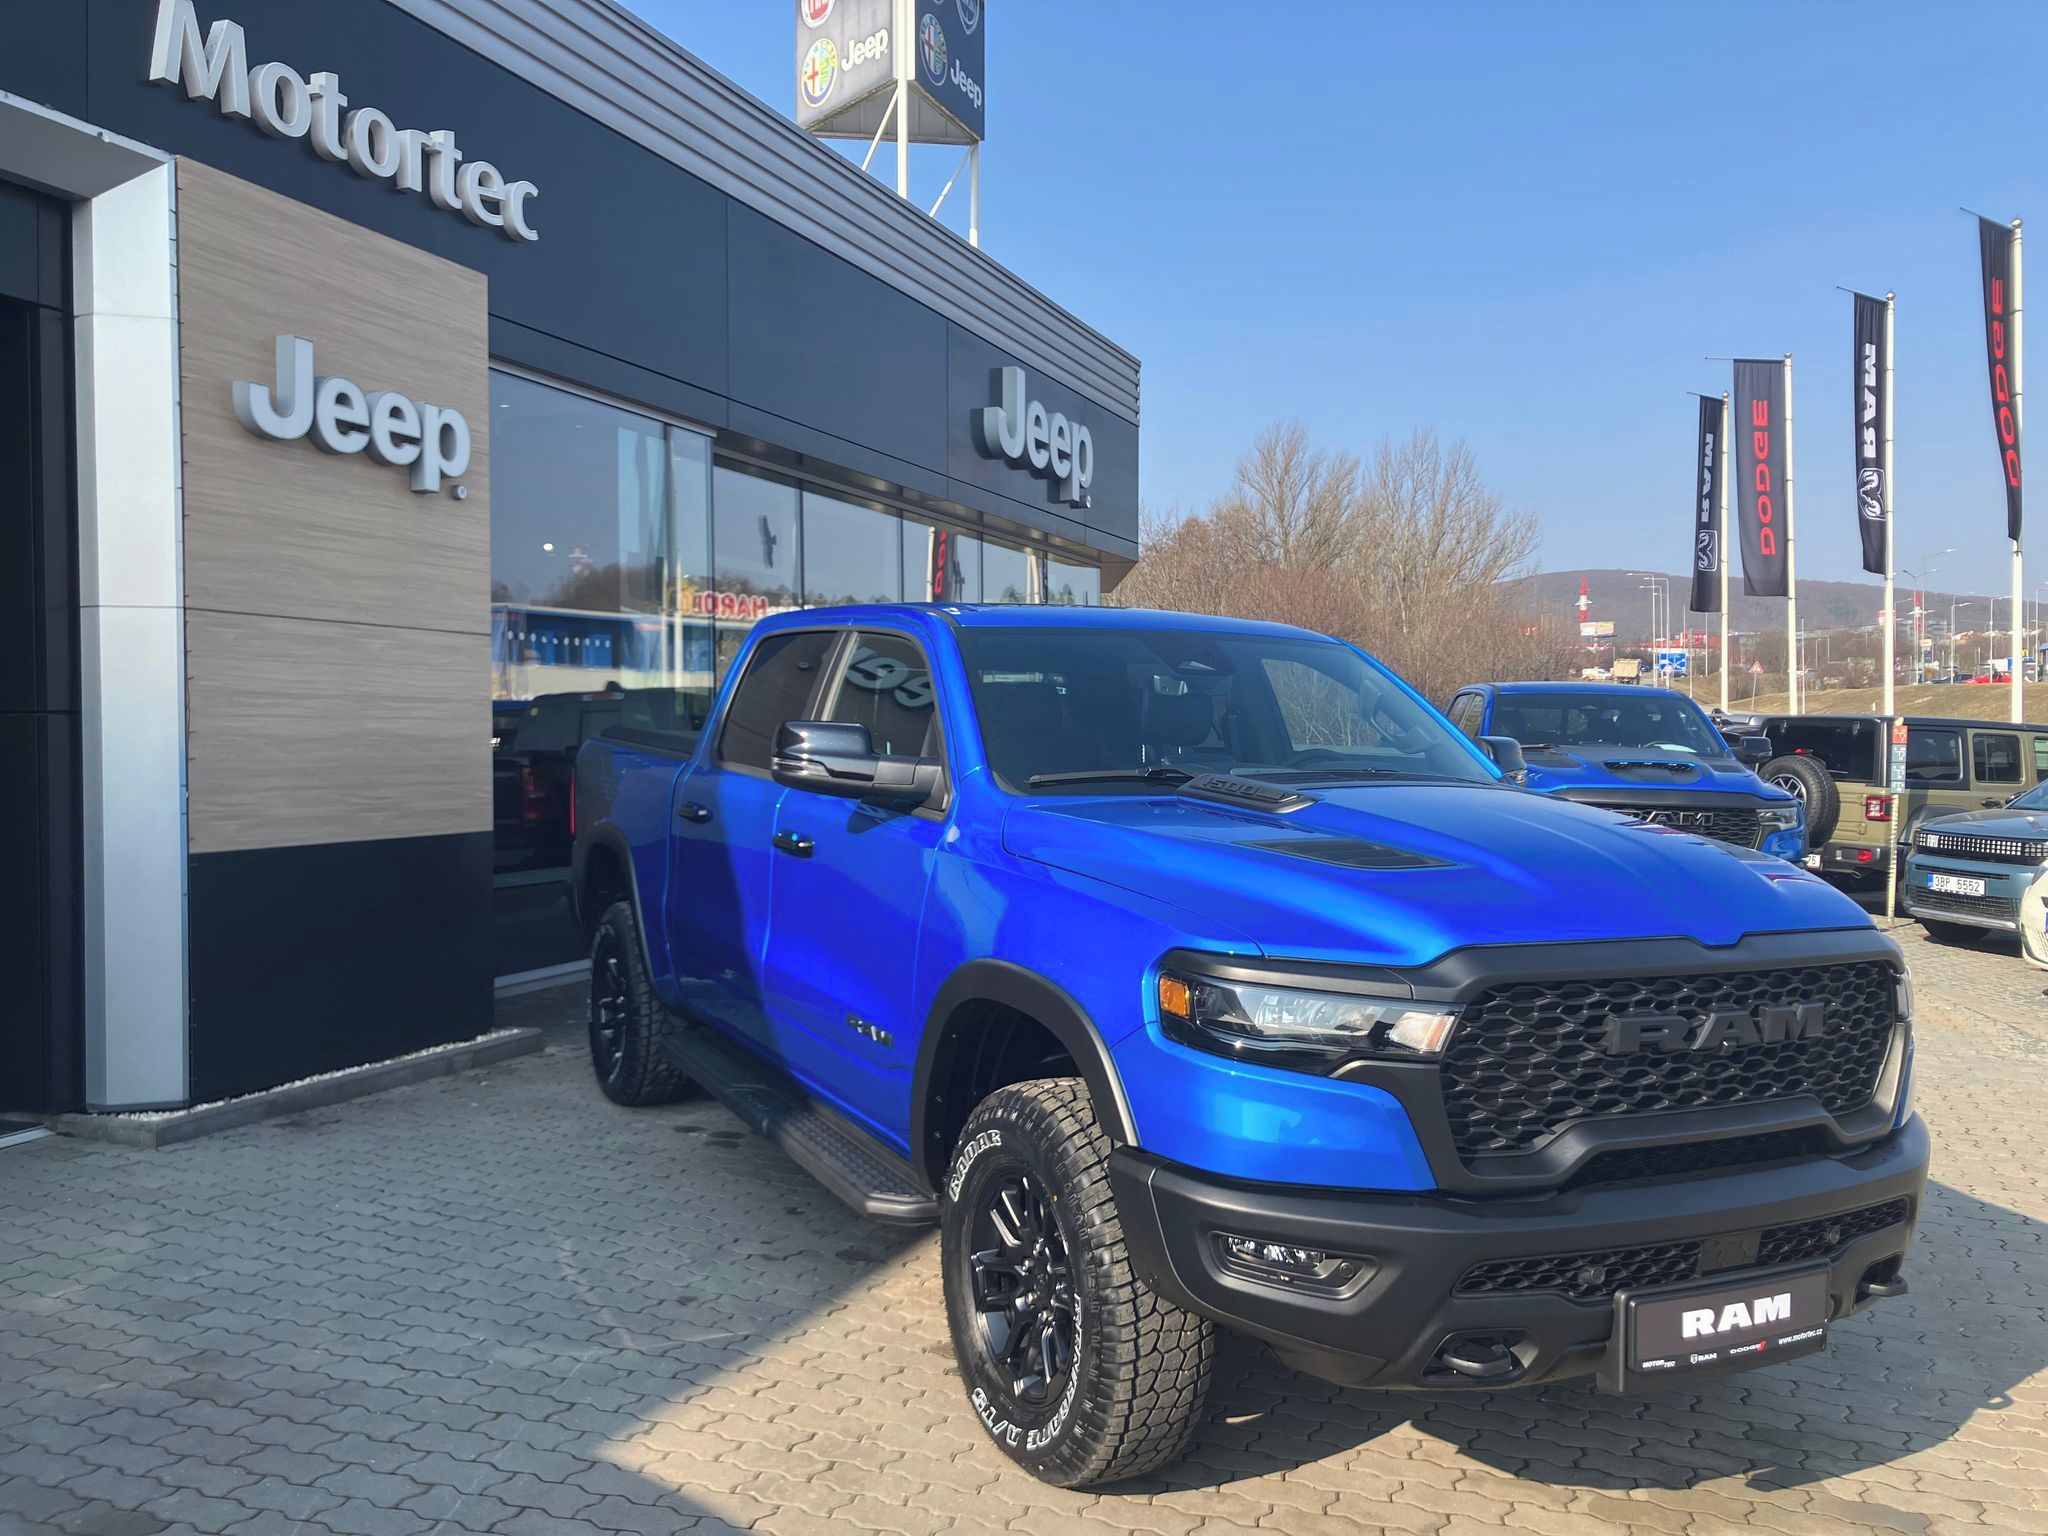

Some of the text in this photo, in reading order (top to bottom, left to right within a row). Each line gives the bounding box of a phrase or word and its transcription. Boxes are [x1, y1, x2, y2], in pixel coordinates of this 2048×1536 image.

[841, 28, 889, 71] Jeep
[950, 59, 982, 109] Jeep
[149, 0, 539, 242] Motortec
[233, 335, 471, 494] Jeep
[984, 366, 1093, 502] Jeep
[1957, 879, 1980, 892] 5552
[1604, 1002, 1825, 1055] RAM
[1682, 1292, 1791, 1338] RAM
[1698, 1352, 1717, 1361] RAM
[1730, 1343, 1761, 1354] DODGE
